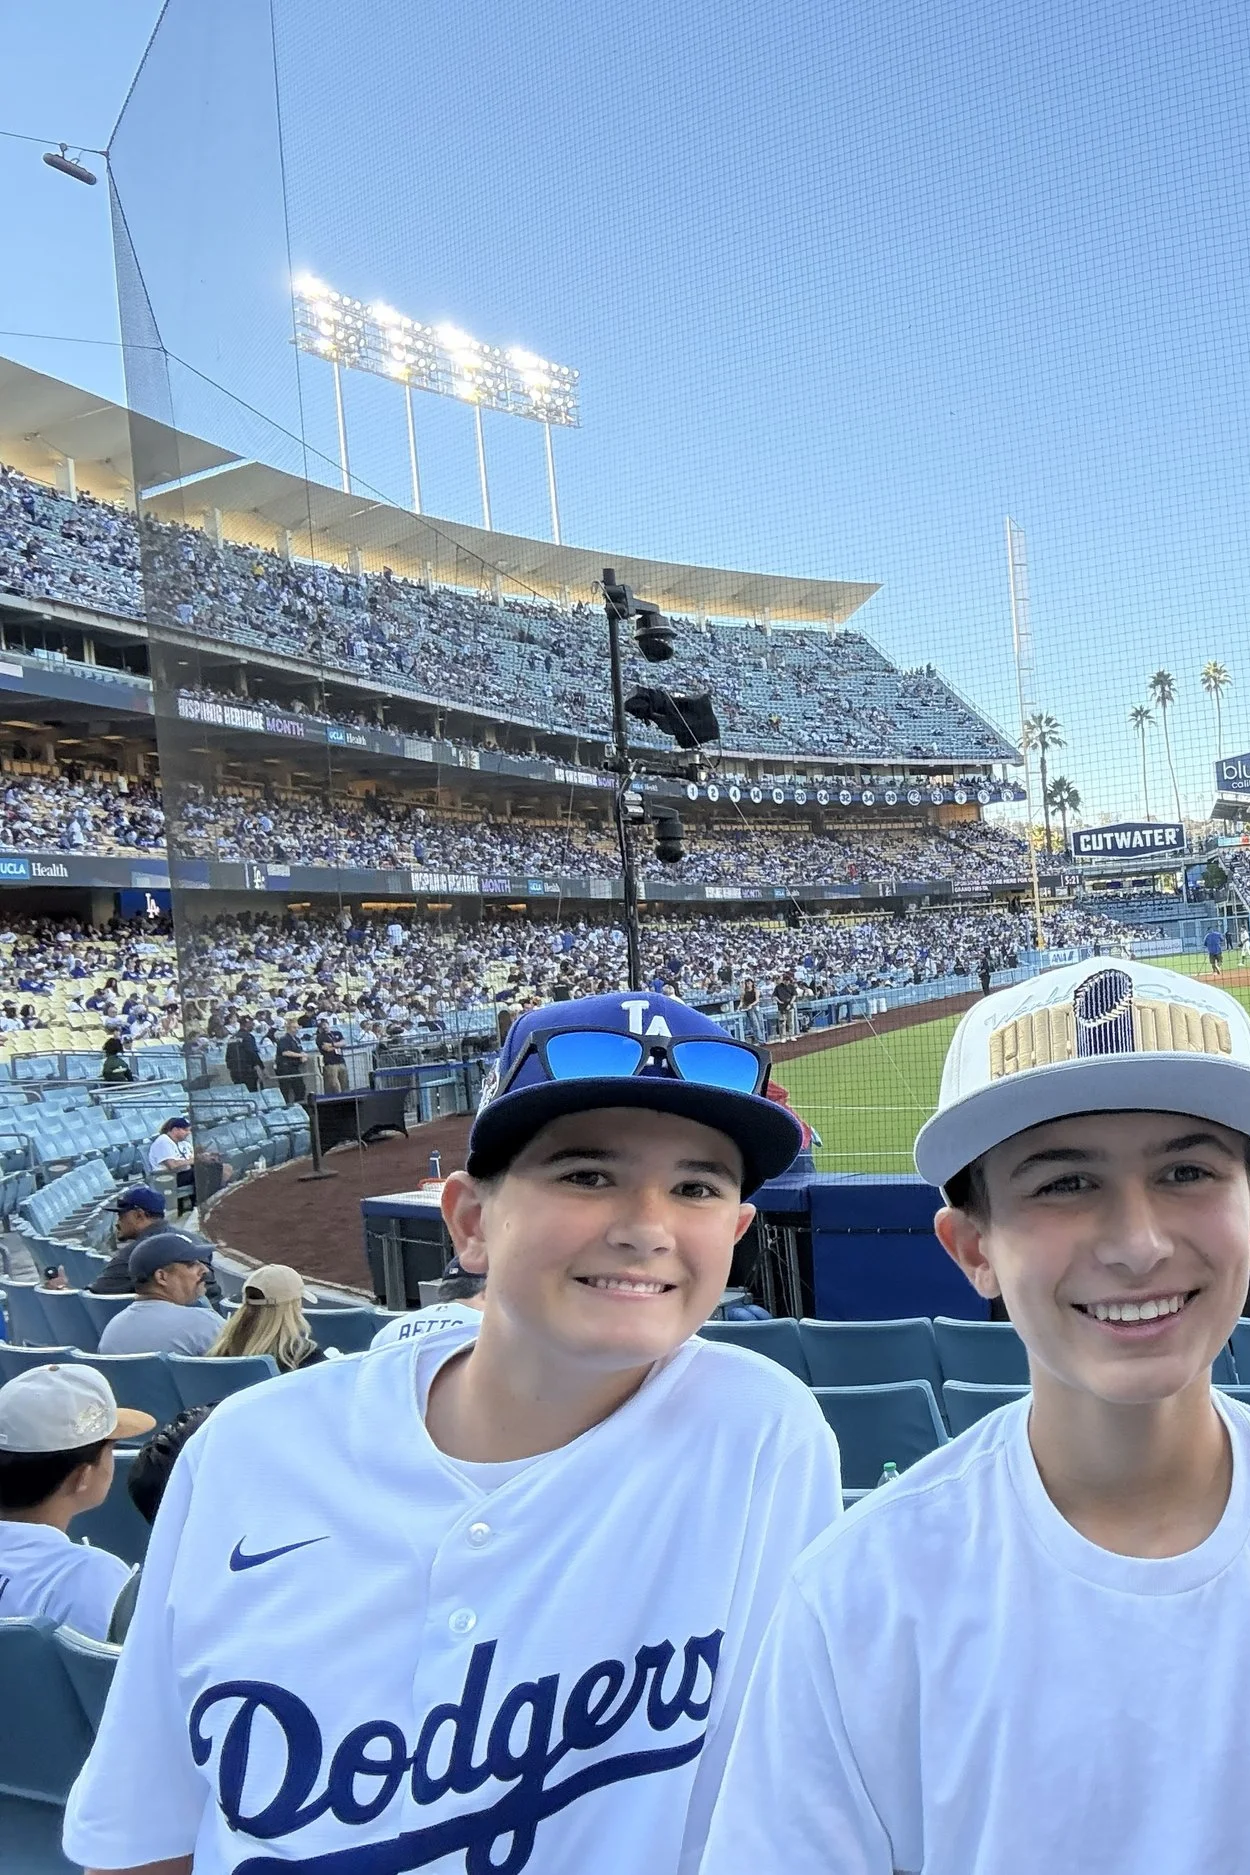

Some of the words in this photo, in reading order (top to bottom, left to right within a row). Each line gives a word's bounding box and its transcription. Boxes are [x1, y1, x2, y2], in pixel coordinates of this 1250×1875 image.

[265, 716, 305, 738] MONTH
[329, 731, 344, 741] UCLA
[346, 732, 367, 746] Health
[818, 793, 829, 802] 24
[840, 793, 851, 802] 32
[909, 793, 921, 803] 42
[1079, 827, 1178, 852] CUTWATER
[1, 861, 26, 875] UCLA
[31, 862, 69, 878] Health
[1064, 875, 1080, 885] 5:21
[481, 878, 511, 894] MONTH
[145, 892, 161, 919] LA
[190, 1629, 724, 1875] Dodgers
